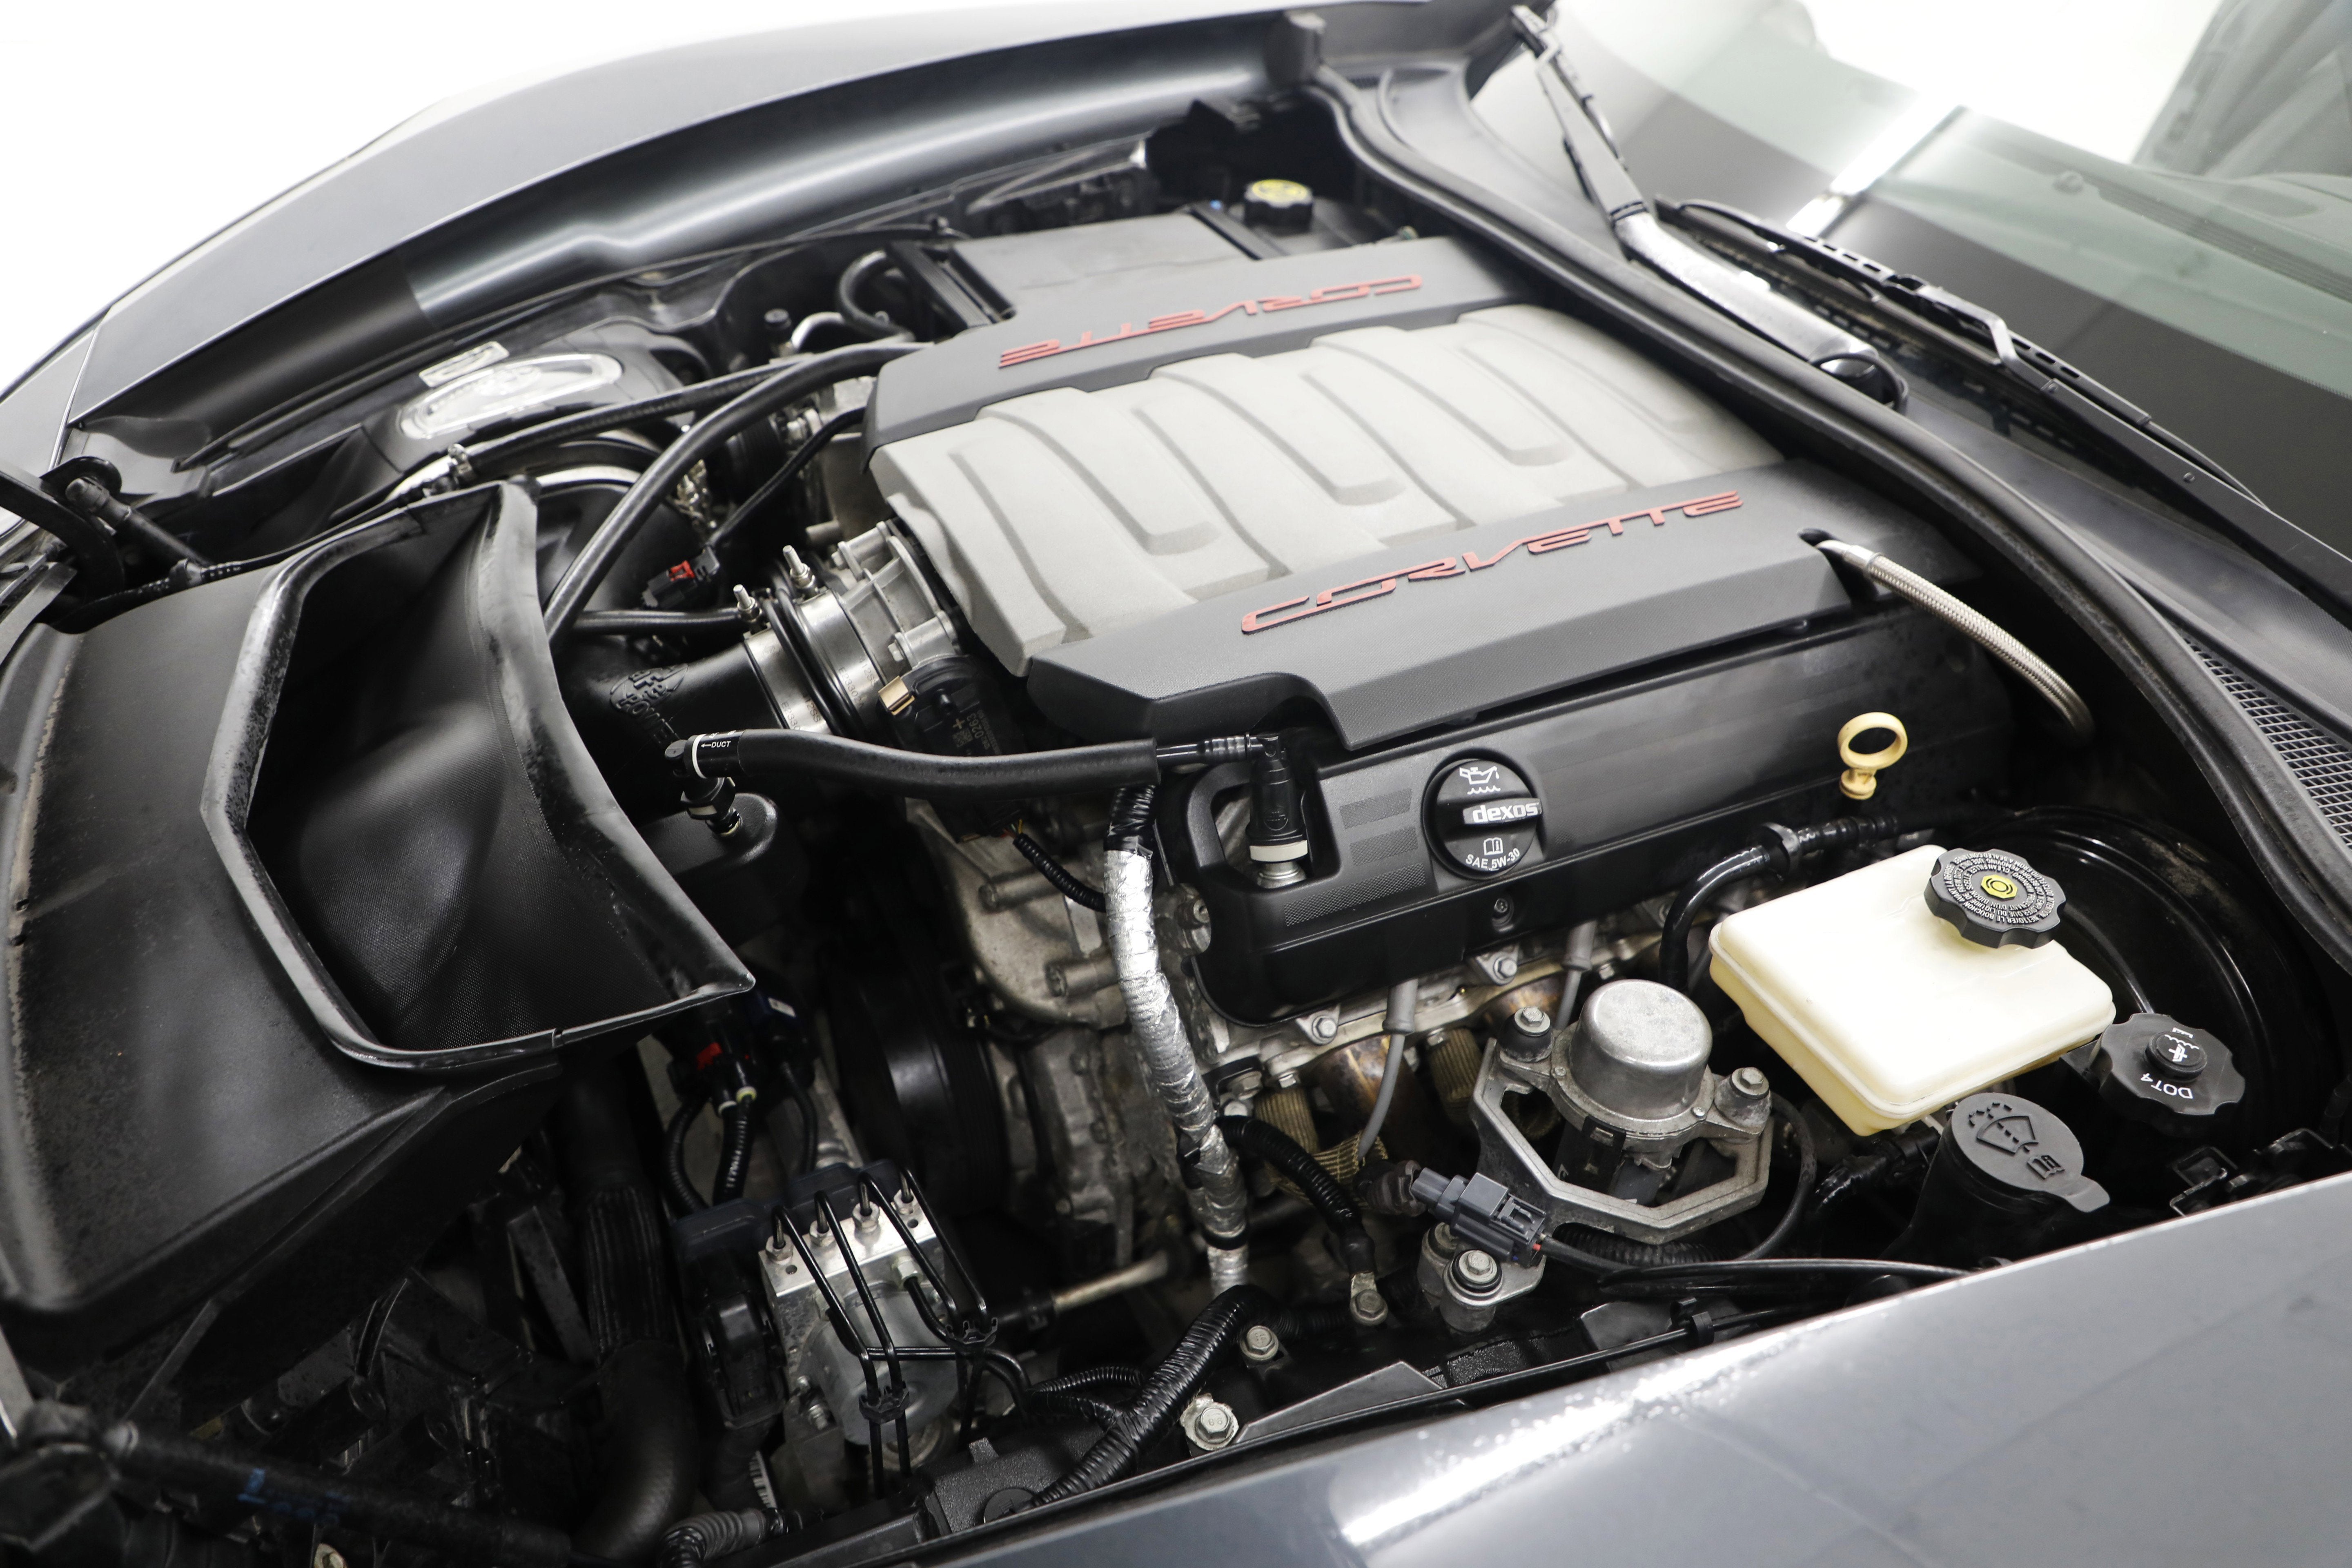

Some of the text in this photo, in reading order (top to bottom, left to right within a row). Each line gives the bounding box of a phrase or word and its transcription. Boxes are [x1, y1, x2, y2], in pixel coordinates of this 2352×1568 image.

[1000, 275, 1422, 367] CORVETTE
[1241, 491, 1743, 632] CORVETTE
[1472, 802, 1539, 823] dexos
[1466, 848, 1520, 869] SAE 5W-30
[1960, 892, 1974, 900] DE
[1961, 901, 1994, 920] BOUCHON
[2140, 1072, 2194, 1099] DOT 4
